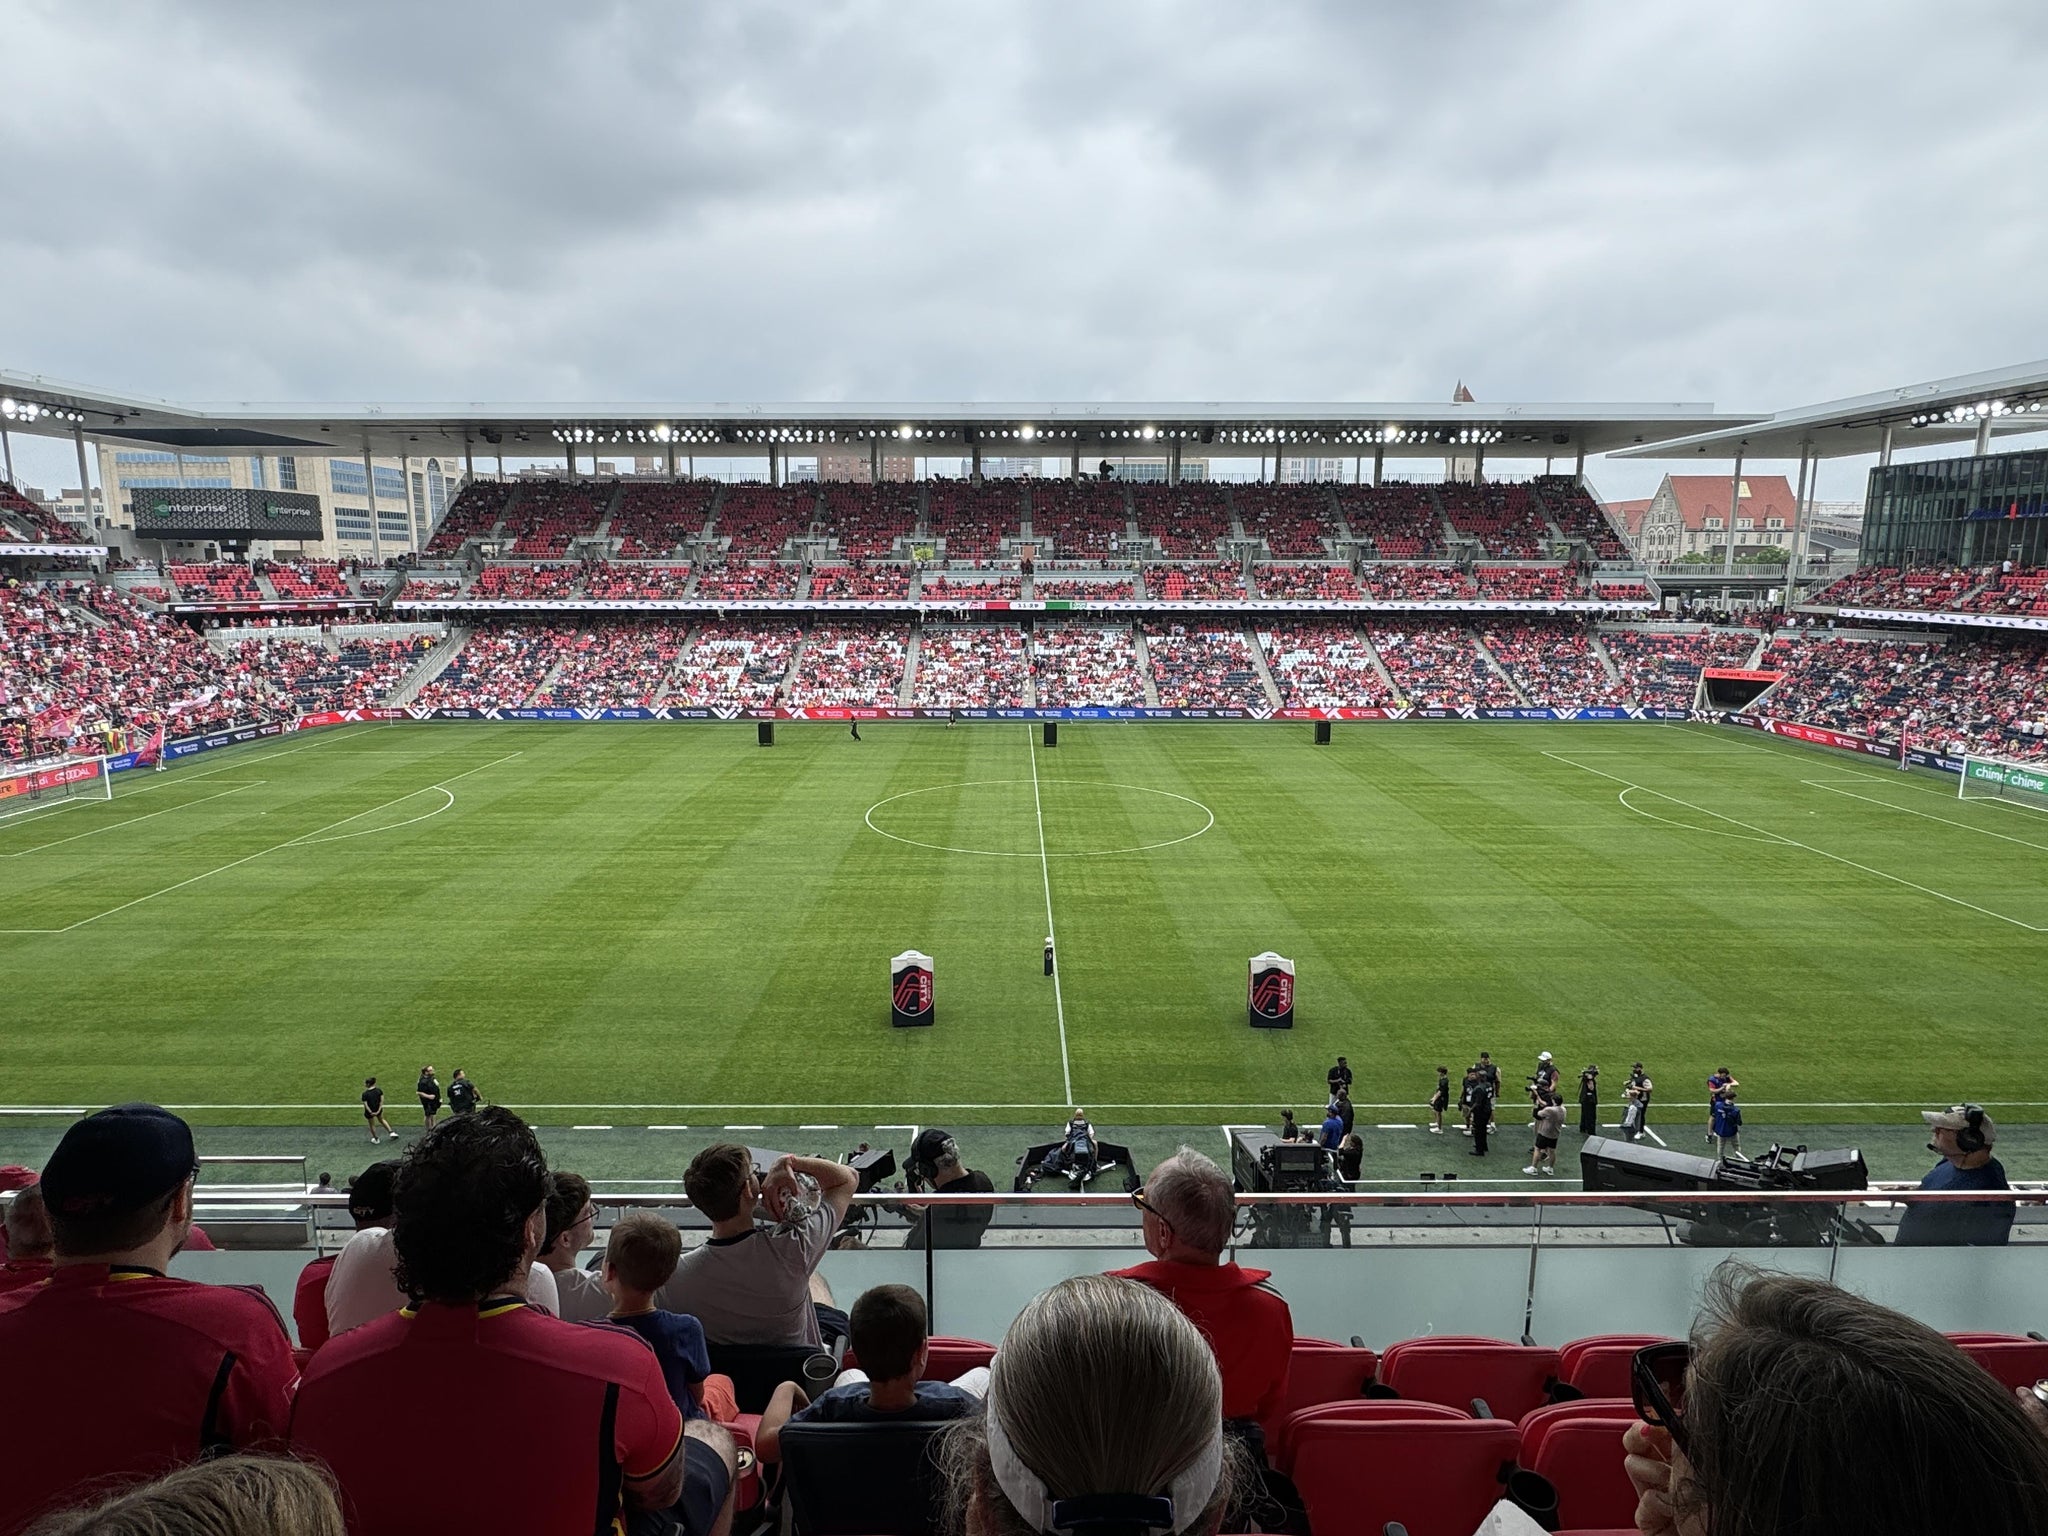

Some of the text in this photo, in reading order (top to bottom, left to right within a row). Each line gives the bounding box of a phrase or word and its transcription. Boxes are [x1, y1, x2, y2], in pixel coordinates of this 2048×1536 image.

[155, 502, 228, 514] enterprise
[269, 505, 311, 517] enterprise
[2011, 774, 2045, 790] chime
[920, 976, 928, 1004] CITY
[1280, 979, 1288, 1007] CITY
